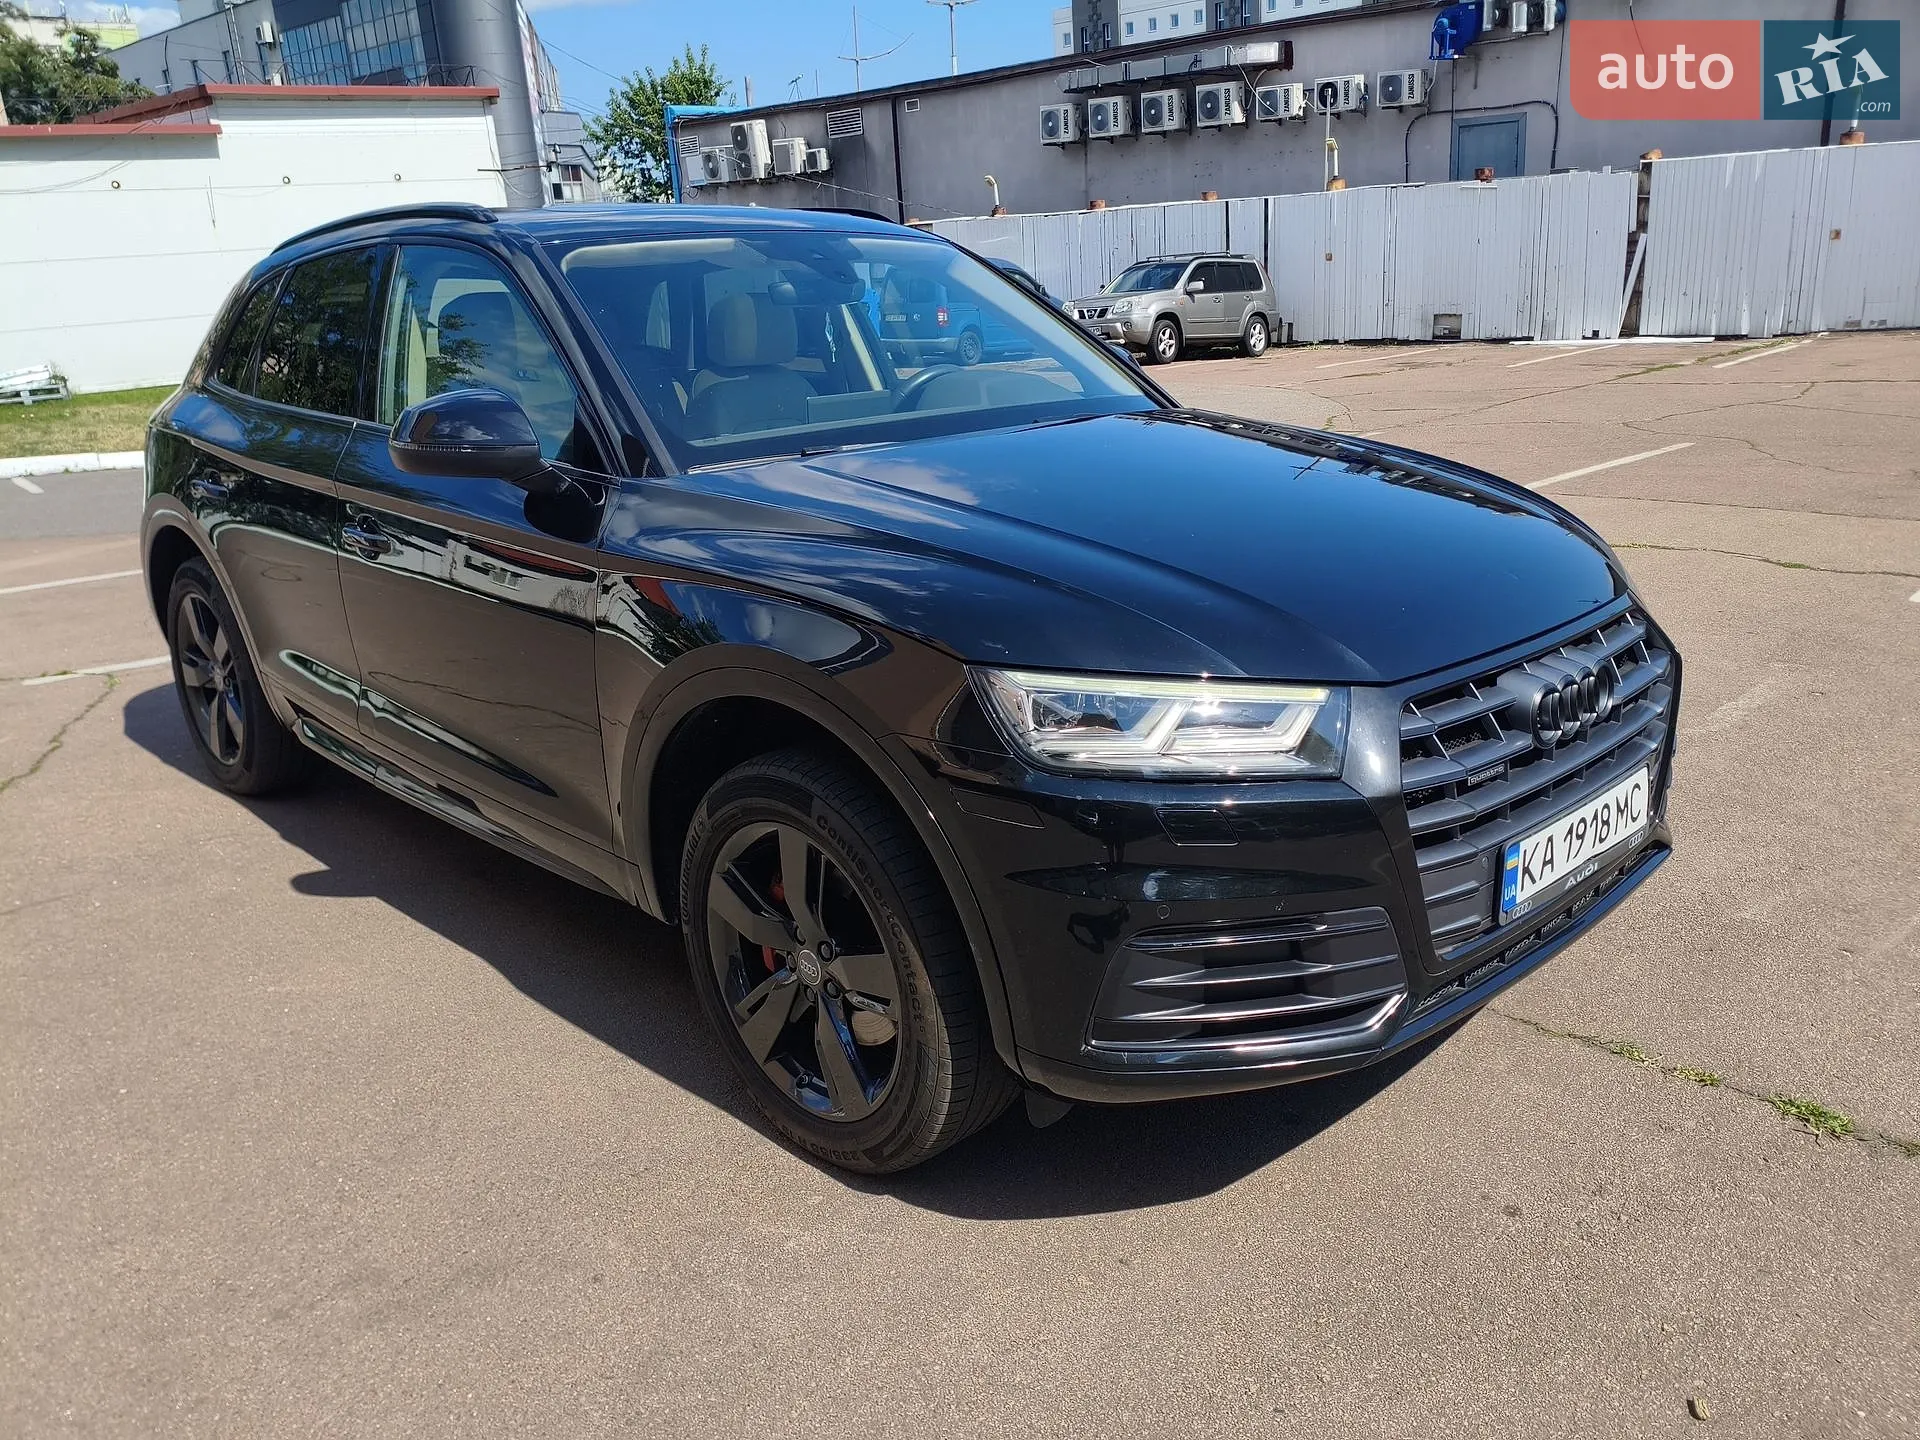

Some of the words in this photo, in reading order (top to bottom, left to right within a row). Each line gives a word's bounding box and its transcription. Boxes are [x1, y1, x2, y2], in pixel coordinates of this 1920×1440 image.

[1223, 88, 1231, 116] ZANUSSI
[1520, 833, 1555, 892] KA
[1563, 803, 1611, 864] 1918
[1613, 782, 1642, 836] MC
[1564, 862, 1599, 890] Audi
[1504, 885, 1517, 900] UA
